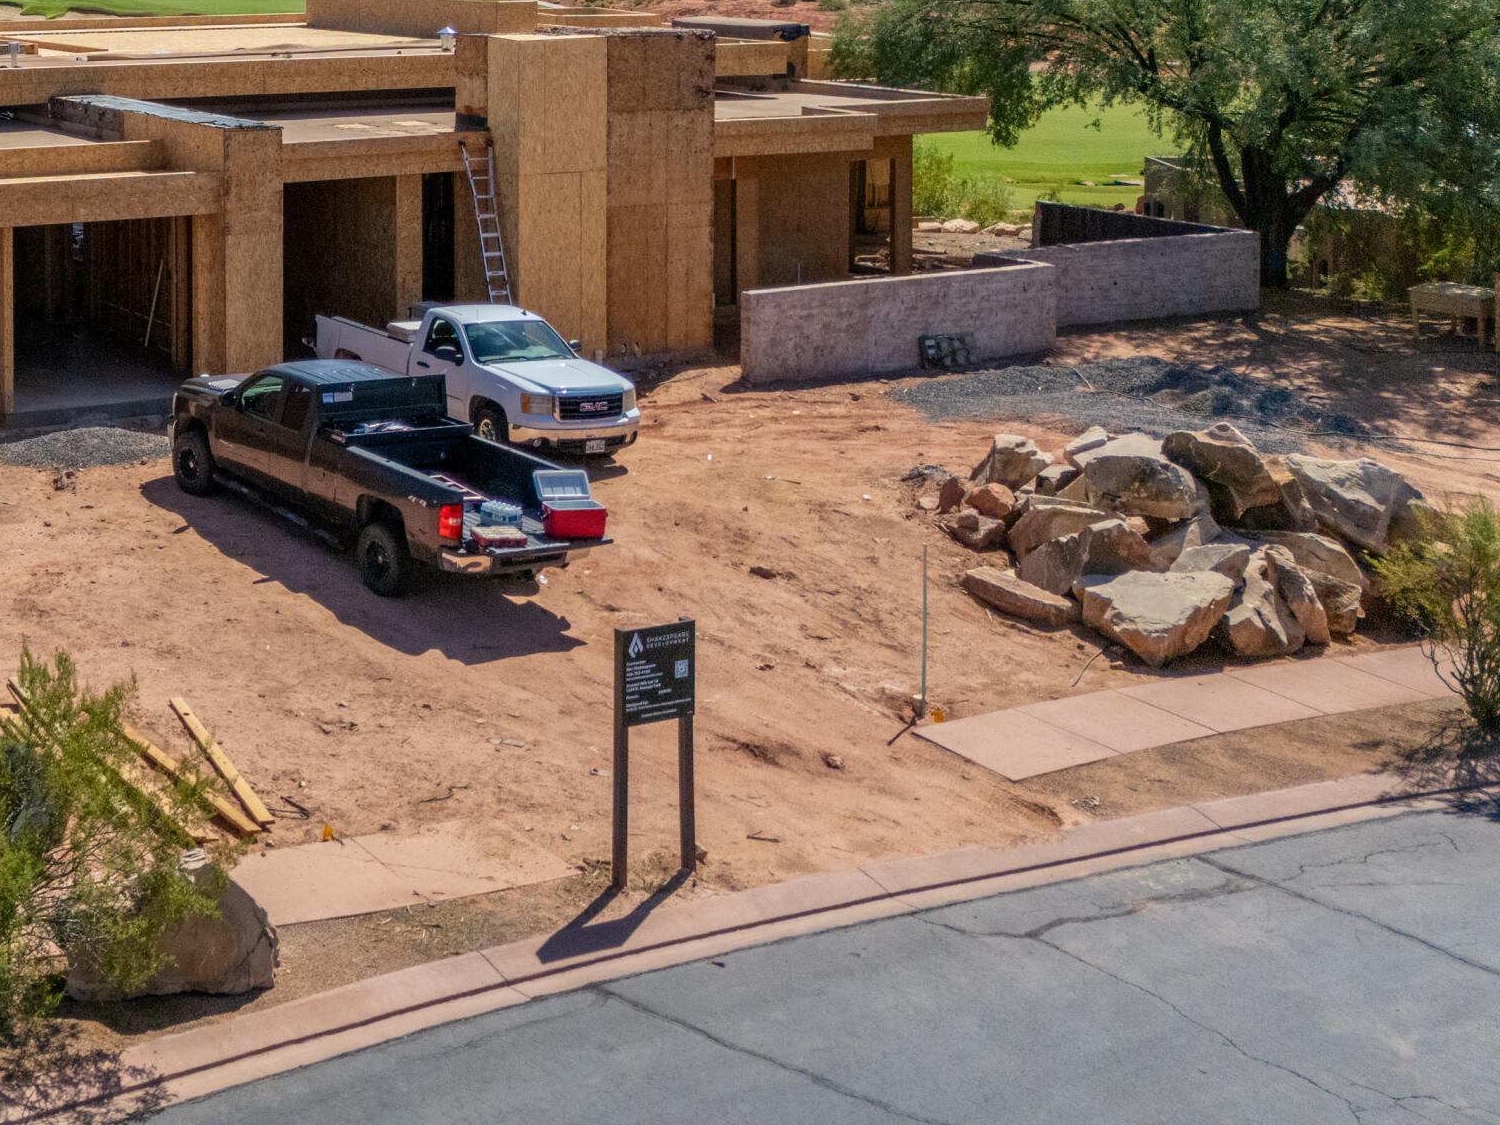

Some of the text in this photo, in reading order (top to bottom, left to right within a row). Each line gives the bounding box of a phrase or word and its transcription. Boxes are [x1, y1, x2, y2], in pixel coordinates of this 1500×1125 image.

[580, 401, 608, 412] GMC
[646, 631, 690, 642] SHAKESPEARE
[646, 638, 689, 649] DEVELOPMENT
